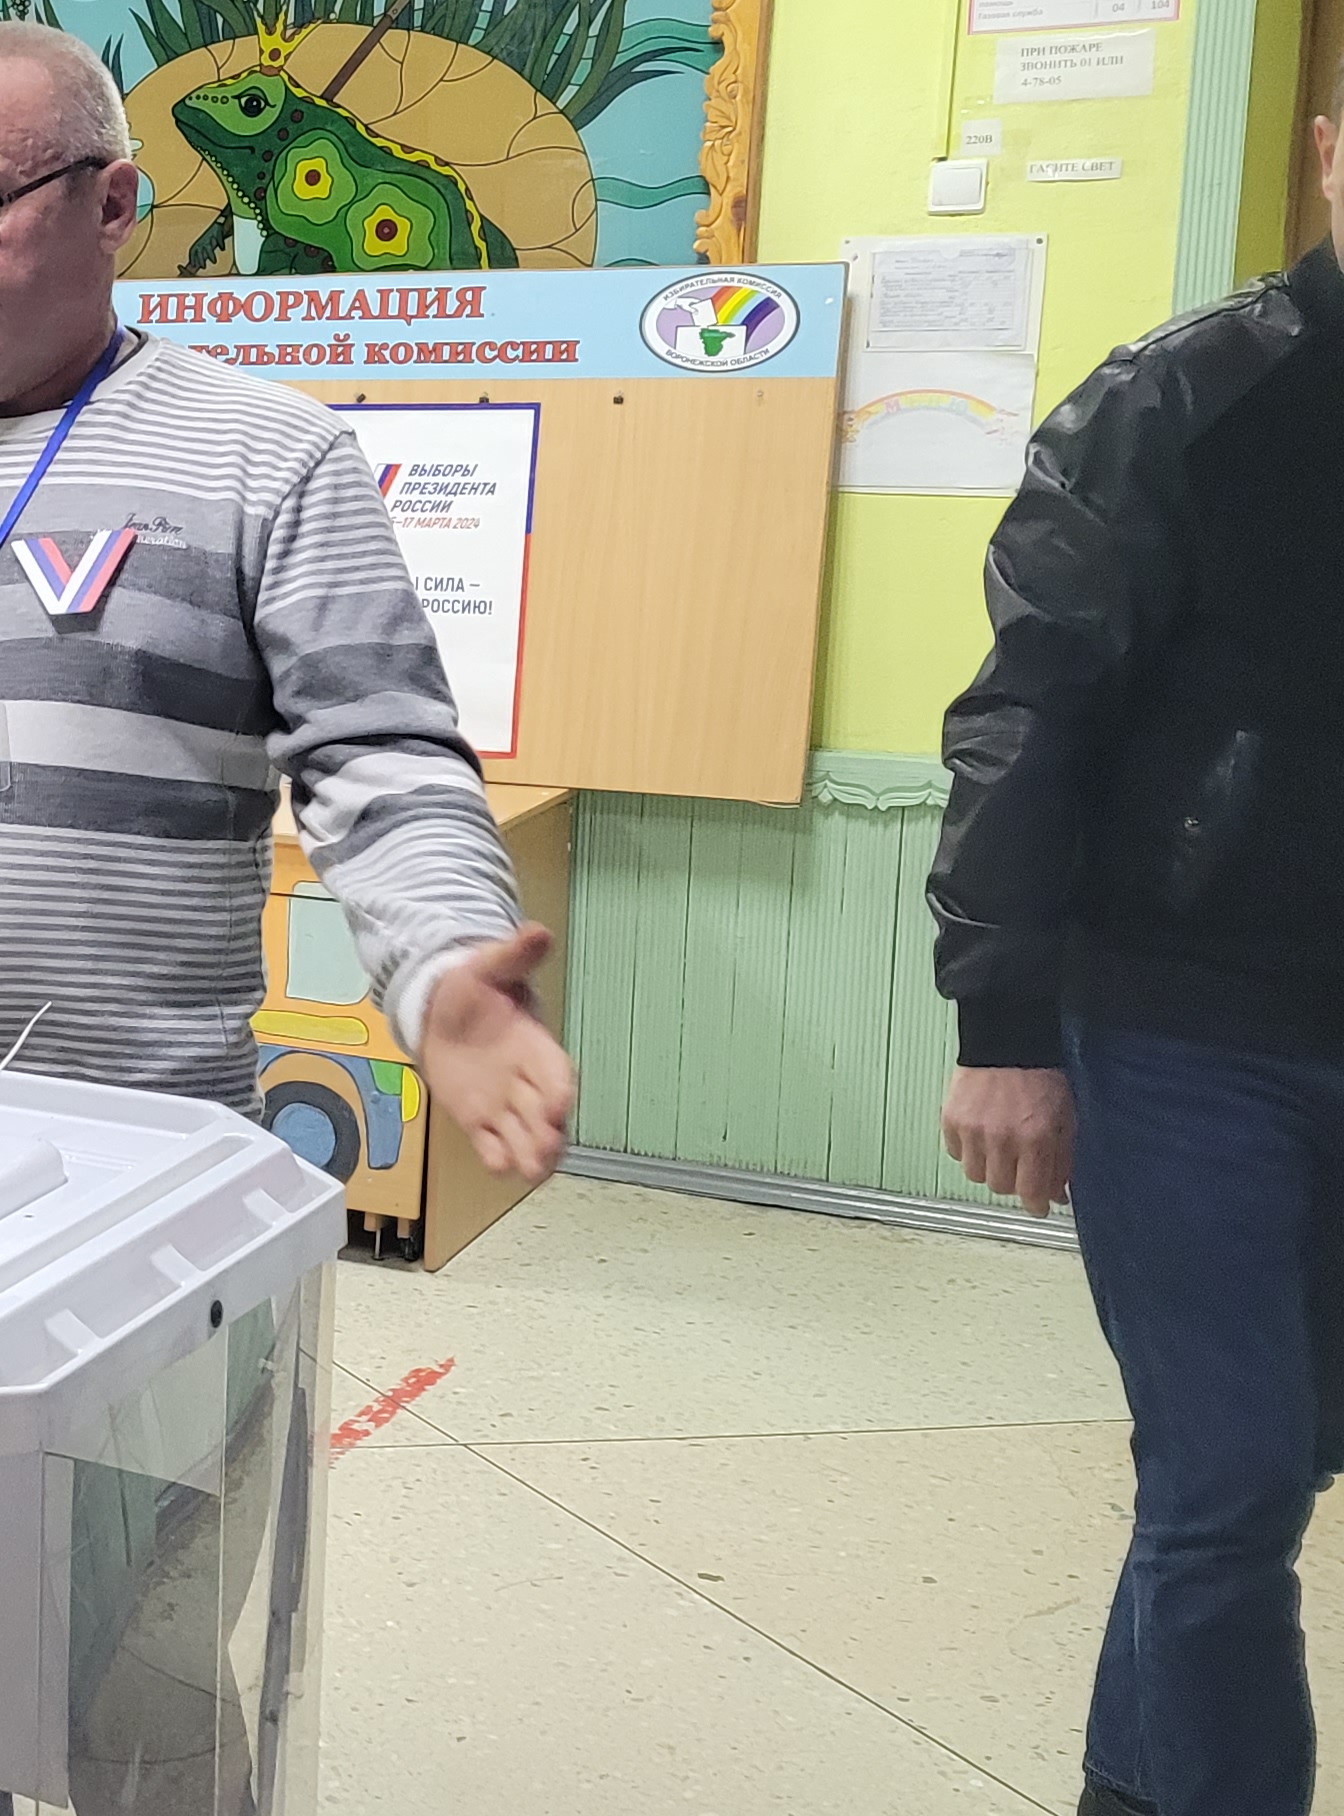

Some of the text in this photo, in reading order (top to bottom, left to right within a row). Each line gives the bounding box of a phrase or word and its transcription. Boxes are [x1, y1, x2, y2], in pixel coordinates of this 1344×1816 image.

[1112, 3, 1125, 13] 04
[1020, 42, 1103, 58] ПРИ ПОЖАРЕ
[1020, 55, 1124, 72] ЗВОНИТЬ 01 ИЛИ
[1020, 75, 1063, 88] 4-78-05
[965, 134, 994, 145] 220В
[1081, 160, 1115, 172] СВЕТ
[662, 277, 783, 301] ИЗБИРАТЕЛЬНАЯ КОМИССИЯ
[136, 286, 488, 327] ИНФОРМАЦИЯ
[188, 333, 581, 366] тельной комиссии
[665, 347, 771, 367] ВОРОНЕЖСКОЙ ОБЛАСТИ
[408, 463, 479, 477] ВЫБОРЫ
[399, 481, 498, 497] ПРЕЗИДЕНТА
[390, 499, 454, 514] РОССИИ
[414, 517, 452, 529] МАРТА
[452, 517, 480, 529] 2024
[424, 577, 465, 592] СИЛА
[422, 598, 492, 615] РОССИЮ!
